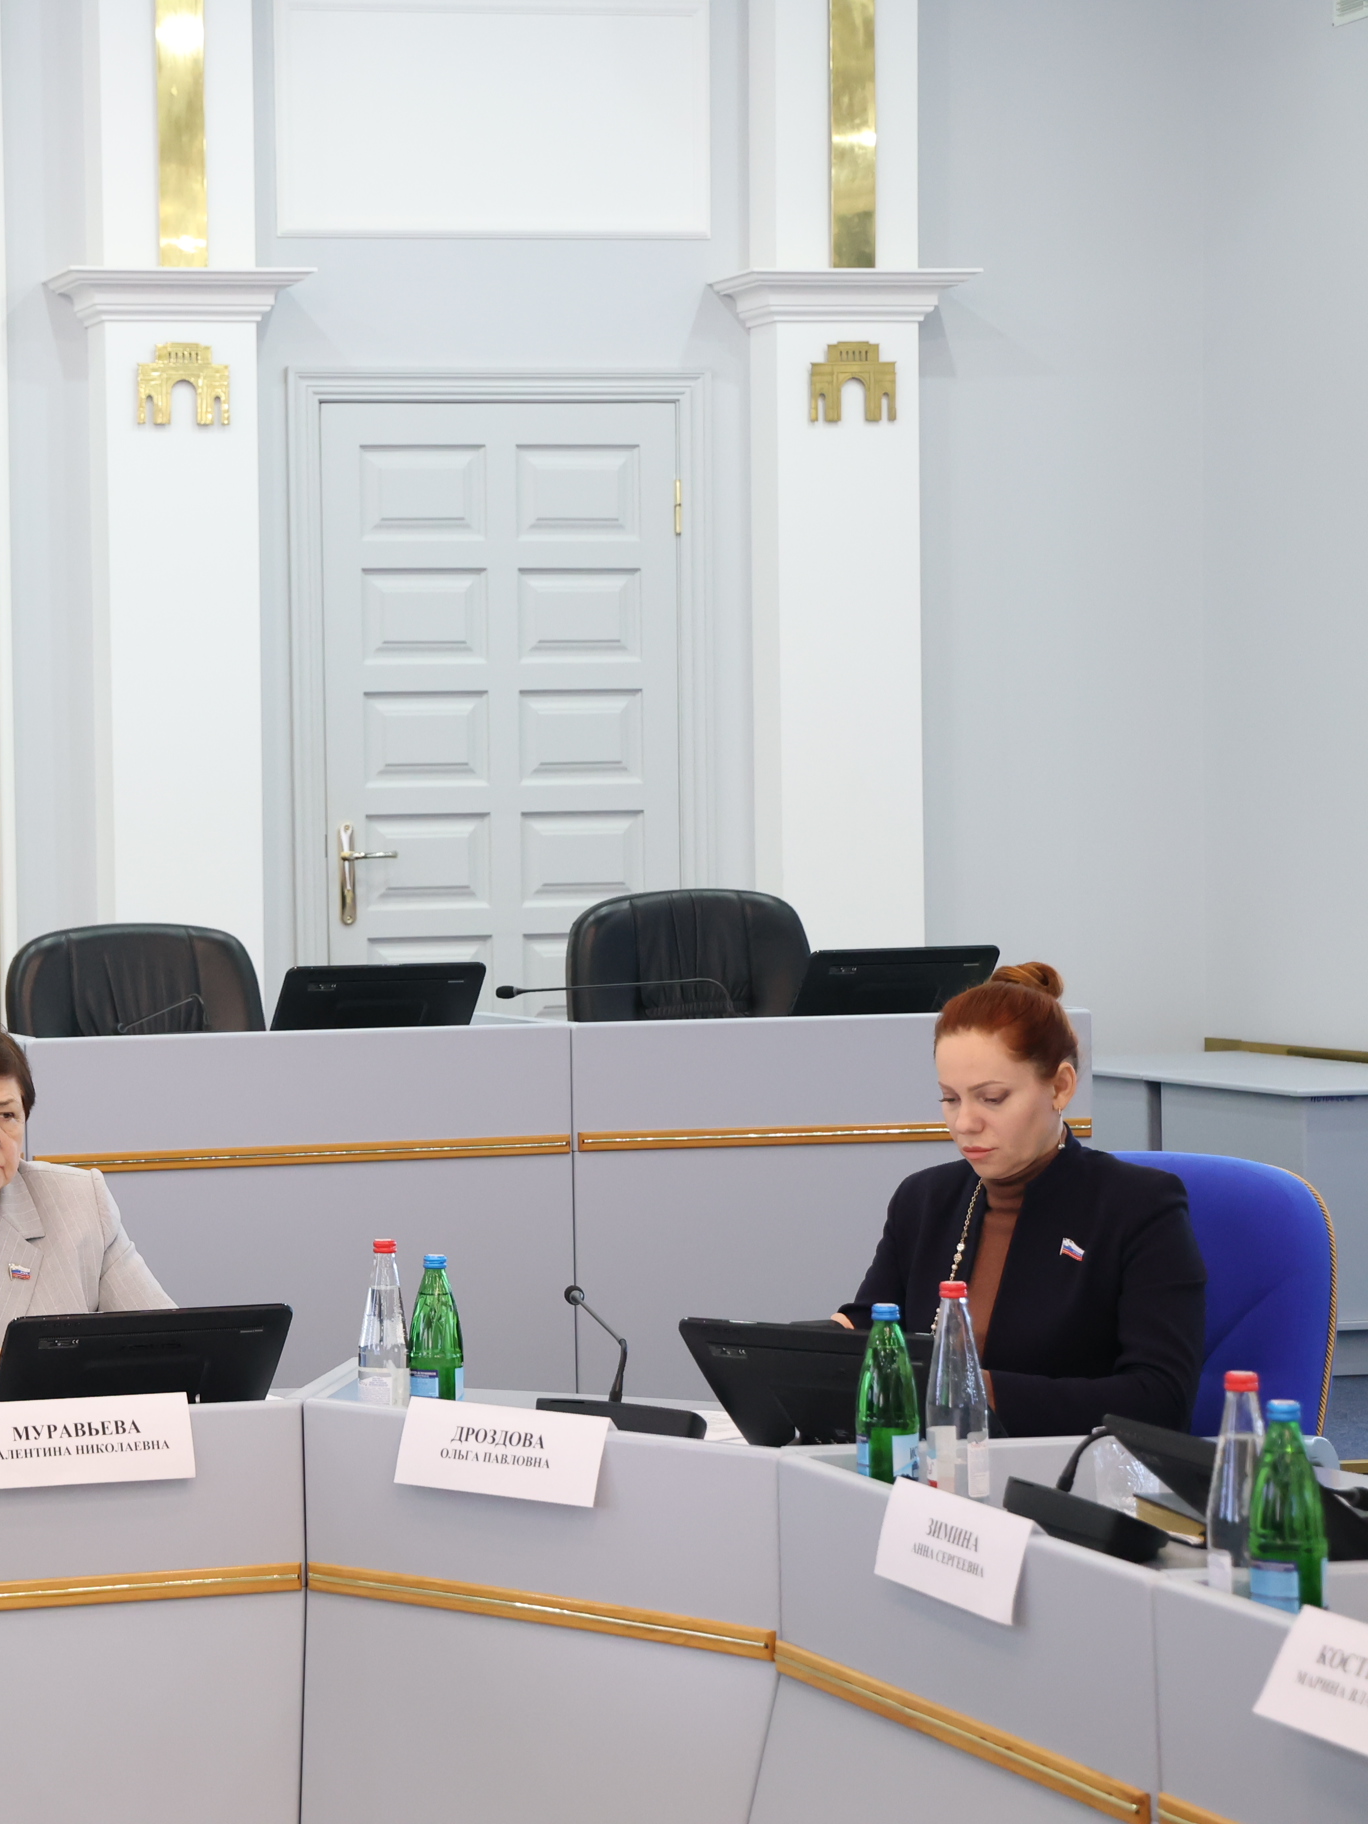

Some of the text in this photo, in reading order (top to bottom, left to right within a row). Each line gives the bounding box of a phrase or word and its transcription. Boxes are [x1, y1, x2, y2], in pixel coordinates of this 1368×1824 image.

[12, 1419, 141, 1442] МУРАВЬЕВА
[451, 1426, 545, 1450] ДРОЗДОВА
[75, 1439, 170, 1455] НИКОЛАЕВНА
[440, 1448, 550, 1470] ОЛЬГА ПАВЛОВНА
[926, 1517, 979, 1552] ЗИМИНА
[911, 1542, 984, 1578] АННА СЕРГЕЕВНА
[1316, 1644, 1368, 1680] КОСТ
